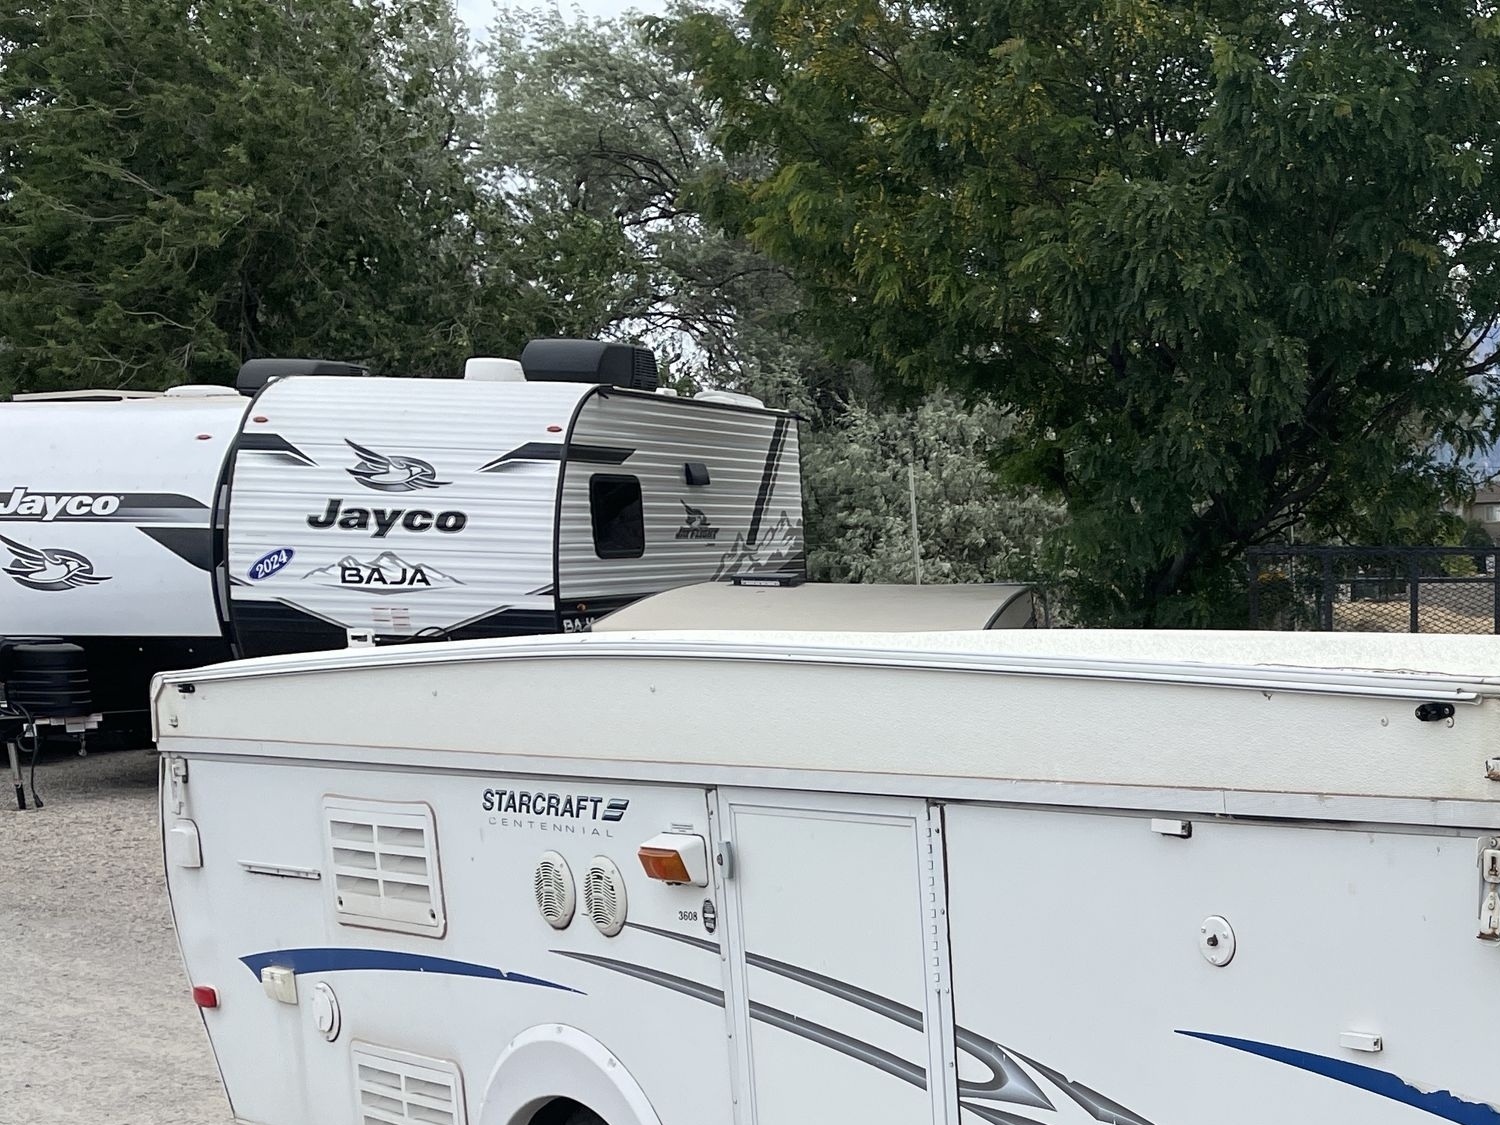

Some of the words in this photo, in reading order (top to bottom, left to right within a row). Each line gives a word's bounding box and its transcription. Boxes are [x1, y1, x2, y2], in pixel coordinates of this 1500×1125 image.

[0, 487, 120, 522] Jayco
[306, 498, 468, 539] Jayco
[255, 549, 289, 579] 2024
[340, 566, 431, 586] BAJA
[482, 788, 604, 822] STARCRAFT
[488, 816, 614, 838] CENTENNIAL
